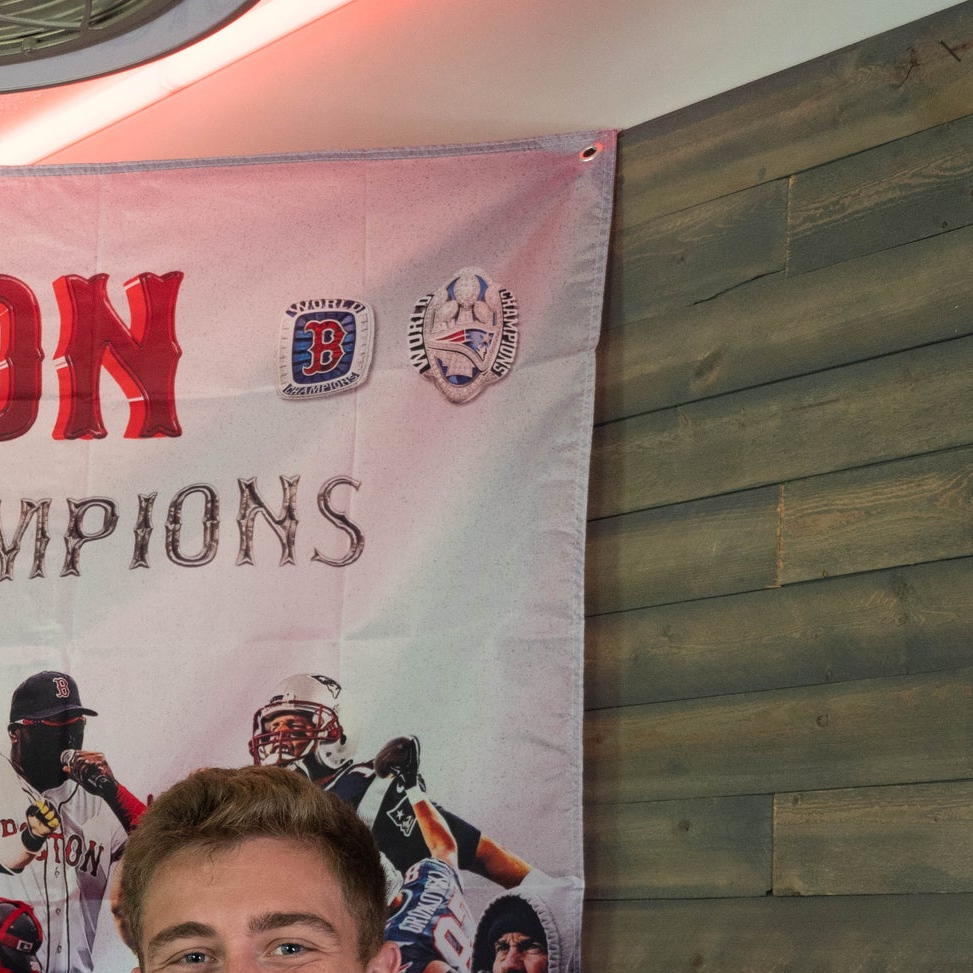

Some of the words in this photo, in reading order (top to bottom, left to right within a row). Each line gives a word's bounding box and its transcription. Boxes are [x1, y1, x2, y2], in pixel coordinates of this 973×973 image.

[285, 299, 367, 317] WORLD
[407, 294, 434, 374] WORLD
[491, 289, 518, 377] CHAMPIONS
[283, 372, 360, 396] CHAMPIONS
[52, 677, 70, 698] B
